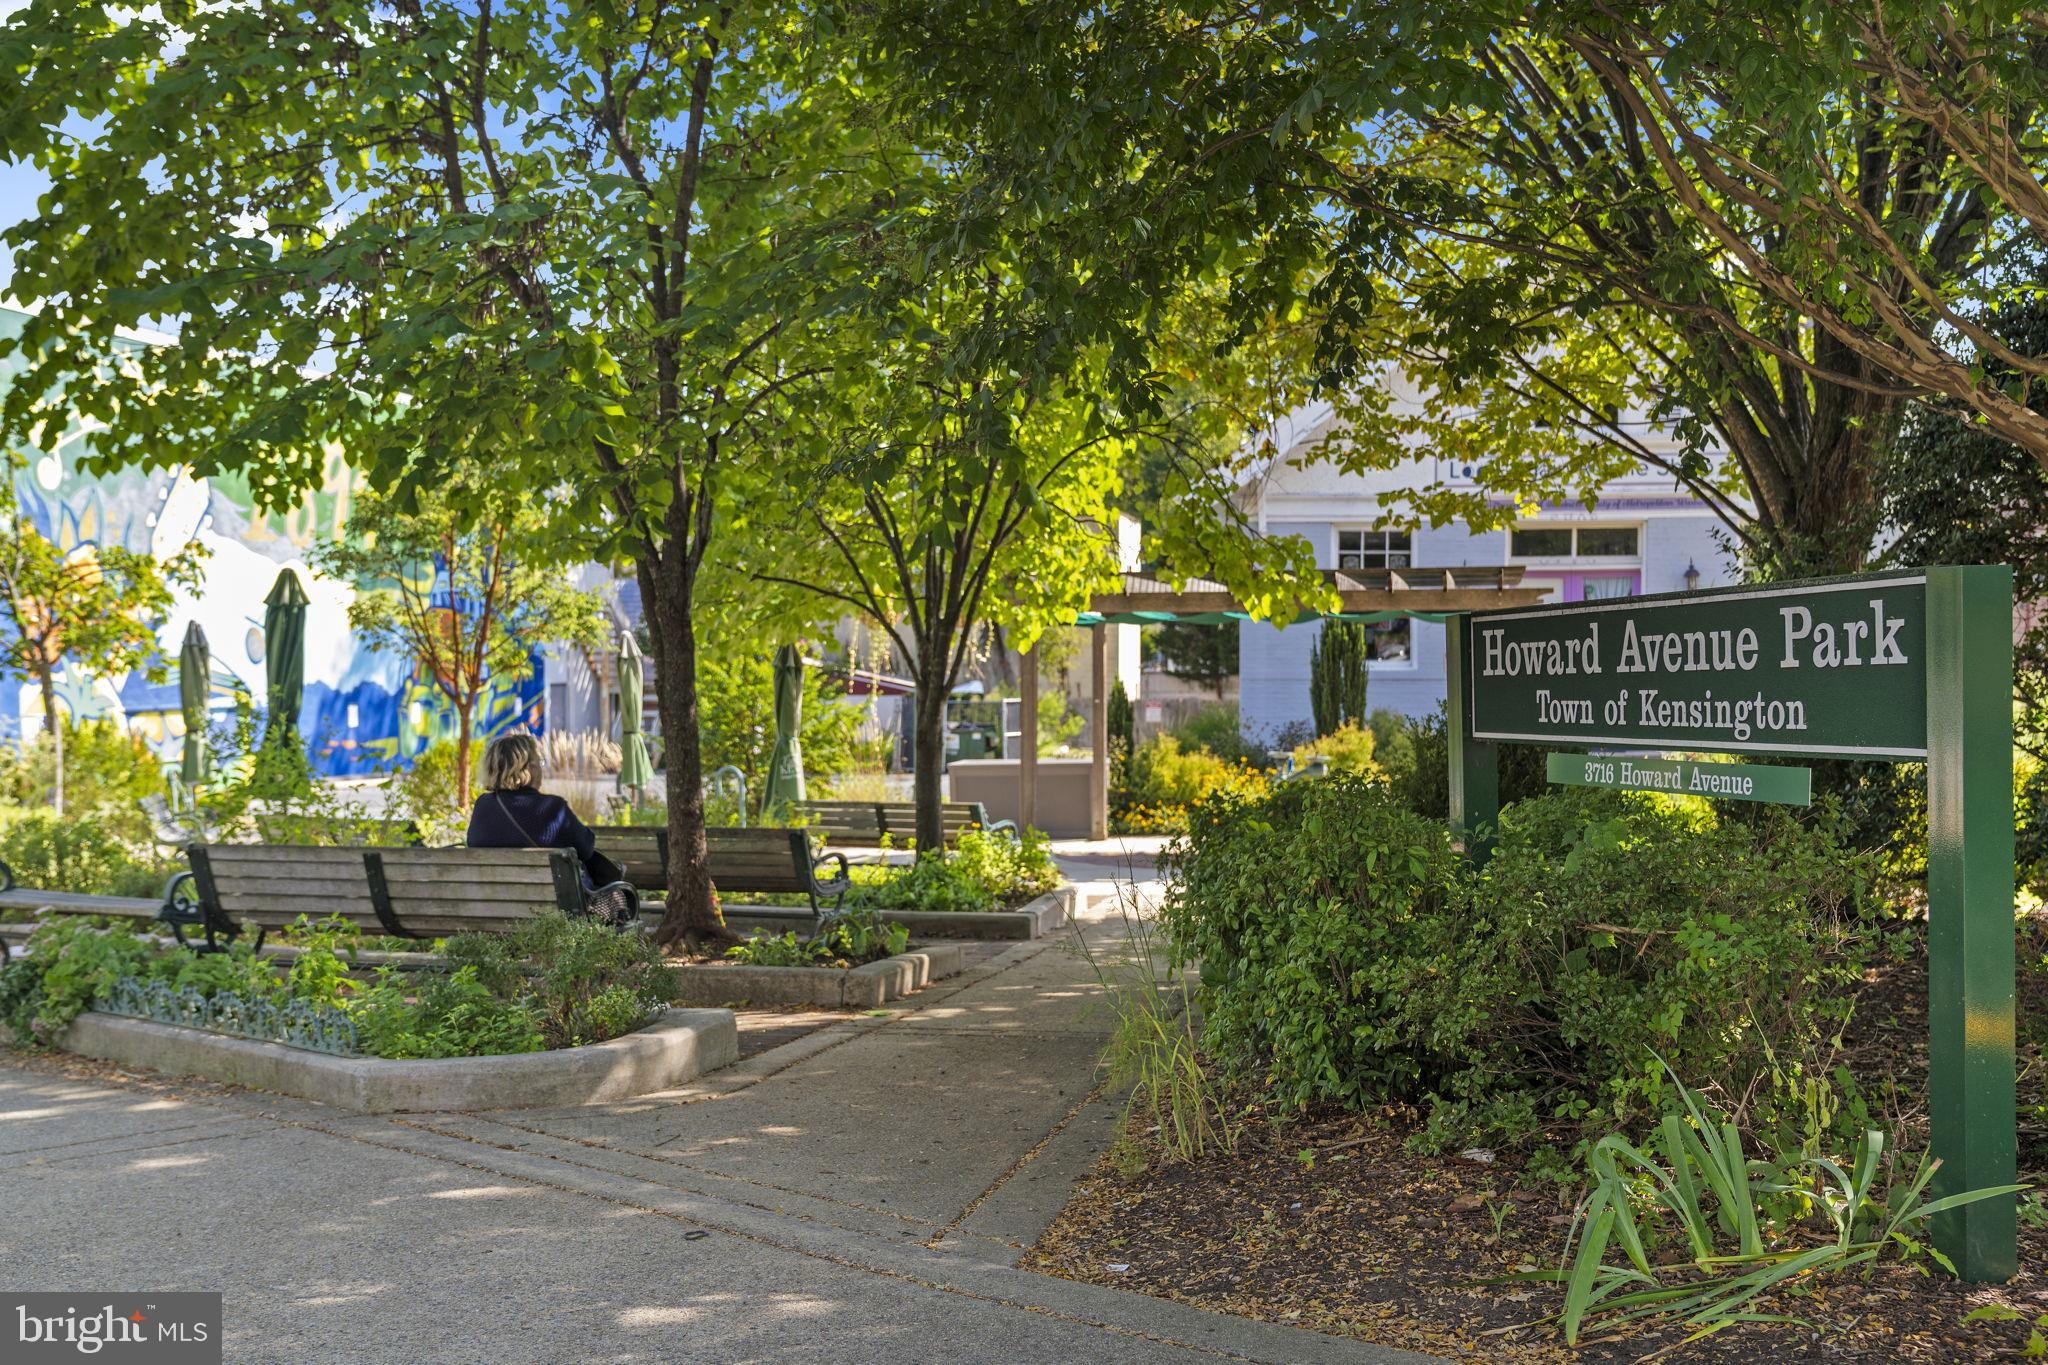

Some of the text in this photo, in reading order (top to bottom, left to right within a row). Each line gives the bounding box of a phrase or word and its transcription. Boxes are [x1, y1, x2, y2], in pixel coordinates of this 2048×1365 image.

[1483, 600, 1908, 675] Howard Avenue Park
[1537, 690, 1807, 740] Town of Kensington
[1585, 762, 1752, 795] 3716 Howard Avenue
